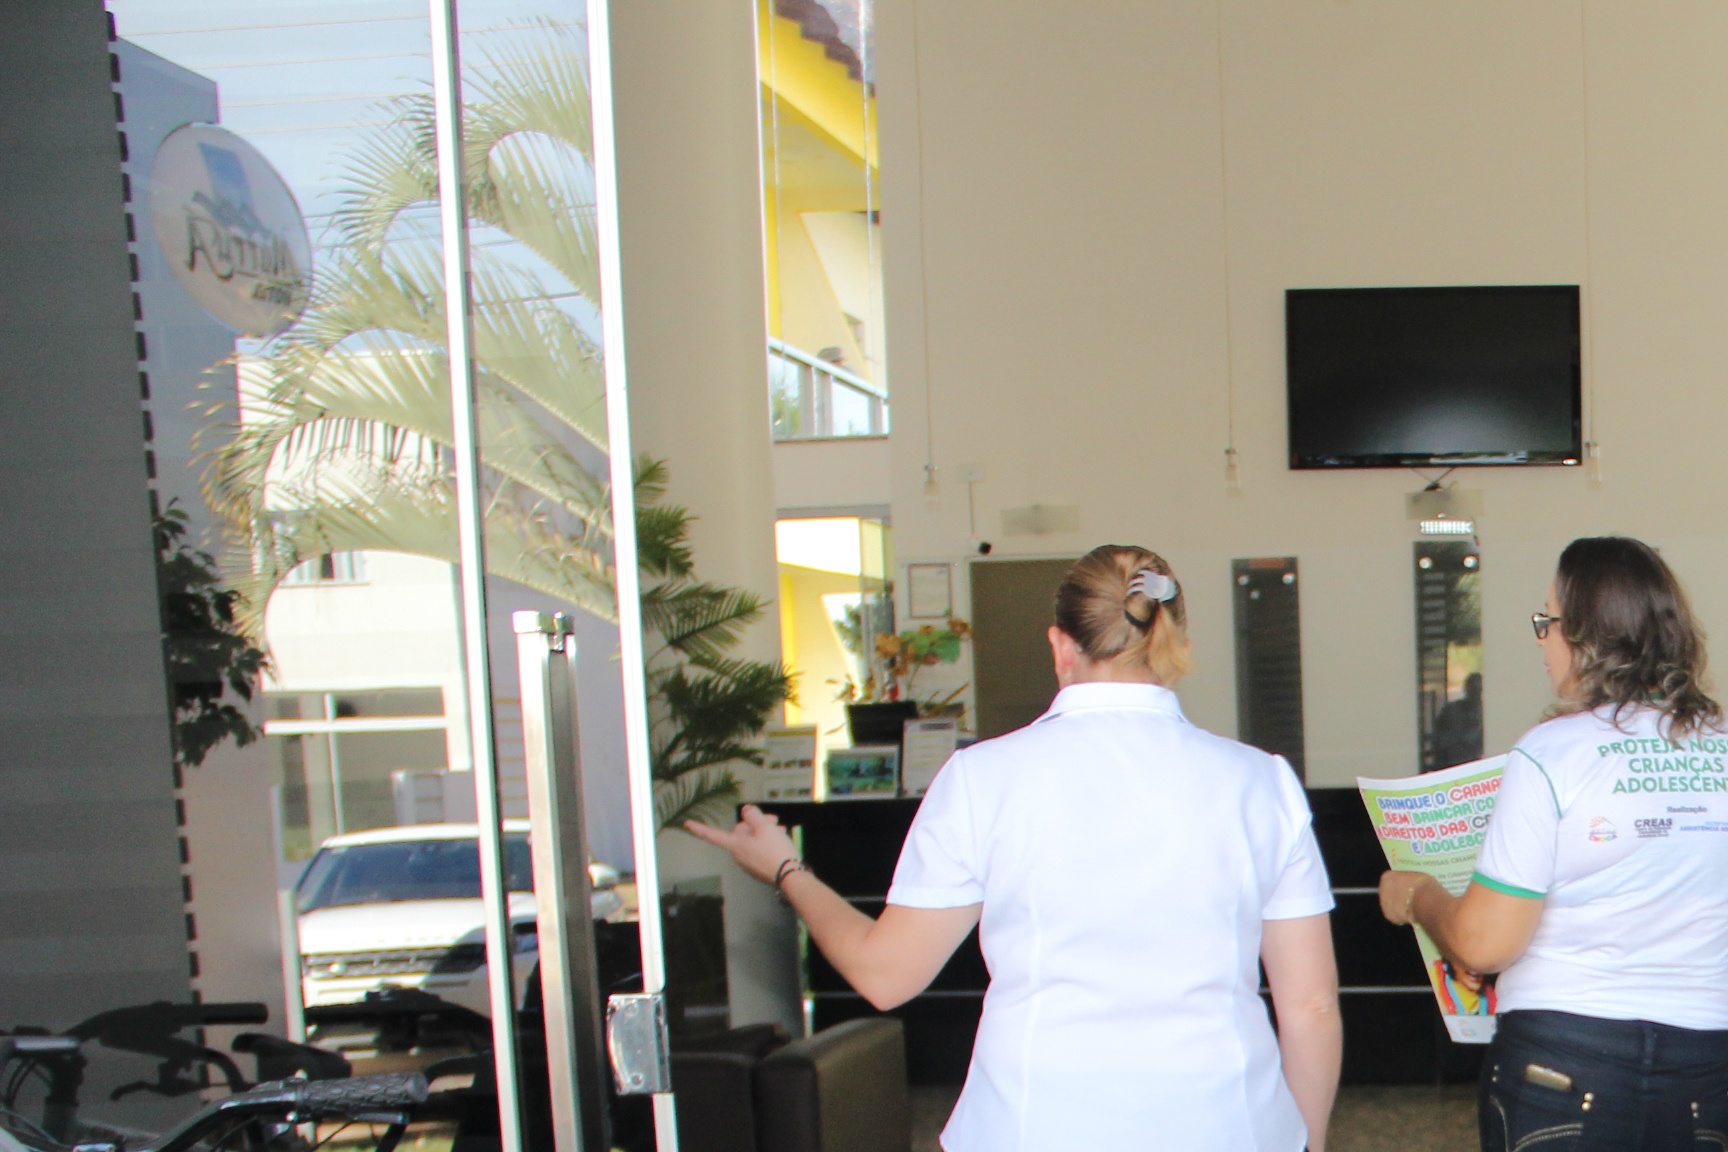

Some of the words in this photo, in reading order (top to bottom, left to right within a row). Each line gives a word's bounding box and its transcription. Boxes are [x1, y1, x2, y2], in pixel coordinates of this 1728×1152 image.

[1628, 756, 1725, 776] CRIANÇAS
[1377, 795, 1432, 810] BRINQUE
[1434, 792, 1446, 806] O
[1450, 777, 1503, 802] CARNA
[1412, 802, 1473, 824] BRINCAR
[1634, 818, 1673, 828] CREAS
[1411, 842, 1421, 855] E
